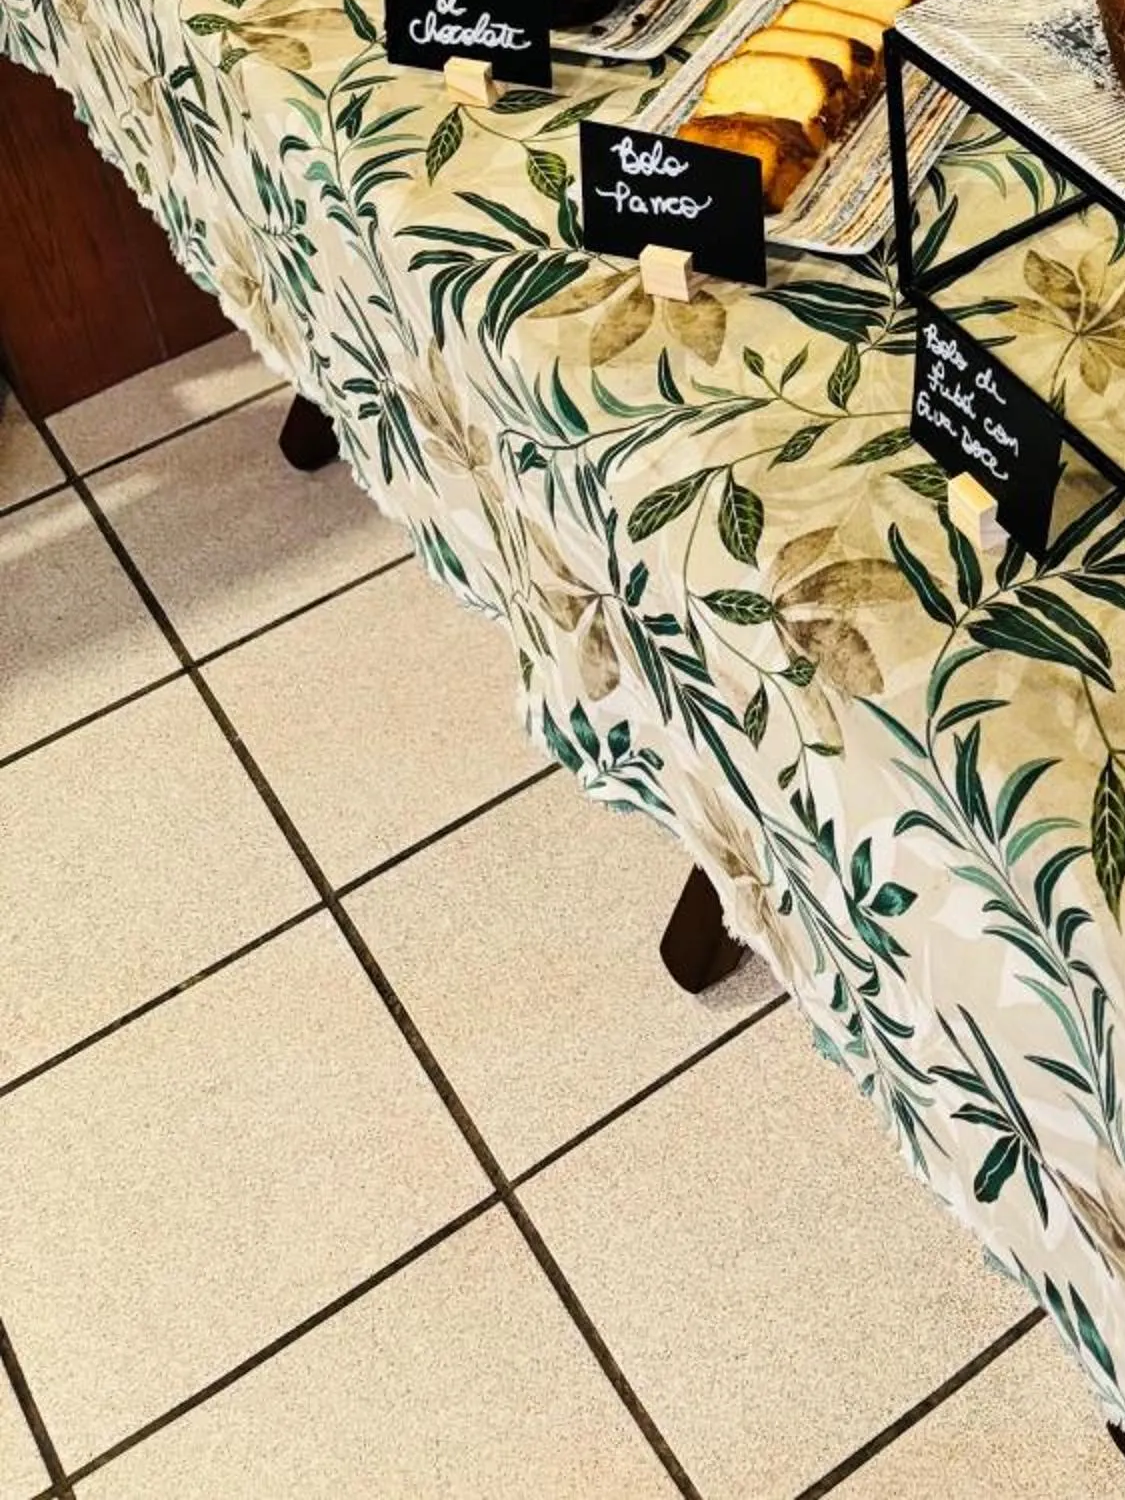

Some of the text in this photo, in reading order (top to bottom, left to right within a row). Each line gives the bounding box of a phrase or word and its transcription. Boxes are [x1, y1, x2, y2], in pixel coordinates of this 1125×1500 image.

[610, 136, 689, 177] Bolo
[596, 181, 713, 219] Panco
[923, 323, 968, 370] Bolo
